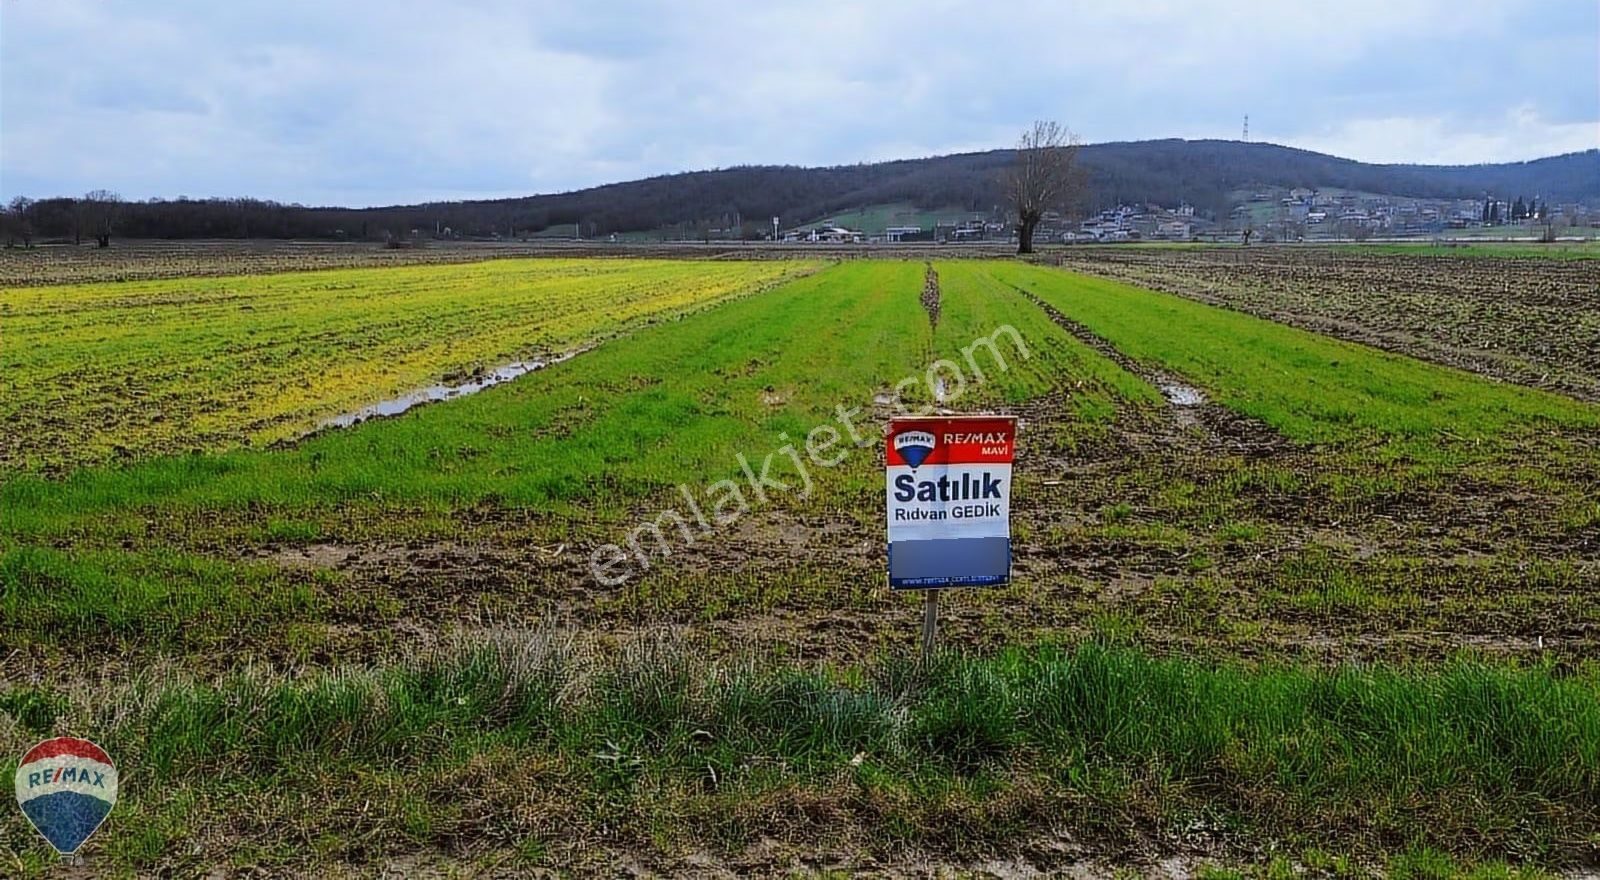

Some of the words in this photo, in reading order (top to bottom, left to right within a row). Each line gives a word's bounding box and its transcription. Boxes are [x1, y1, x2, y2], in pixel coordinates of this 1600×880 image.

[898, 435, 932, 443] RE/MAX
[944, 432, 1007, 444] RE/MAX
[982, 446, 1008, 455] MAVİ
[894, 472, 1002, 502] Satılık
[895, 508, 947, 521] Rıdvan
[952, 502, 1000, 518] GEDİK
